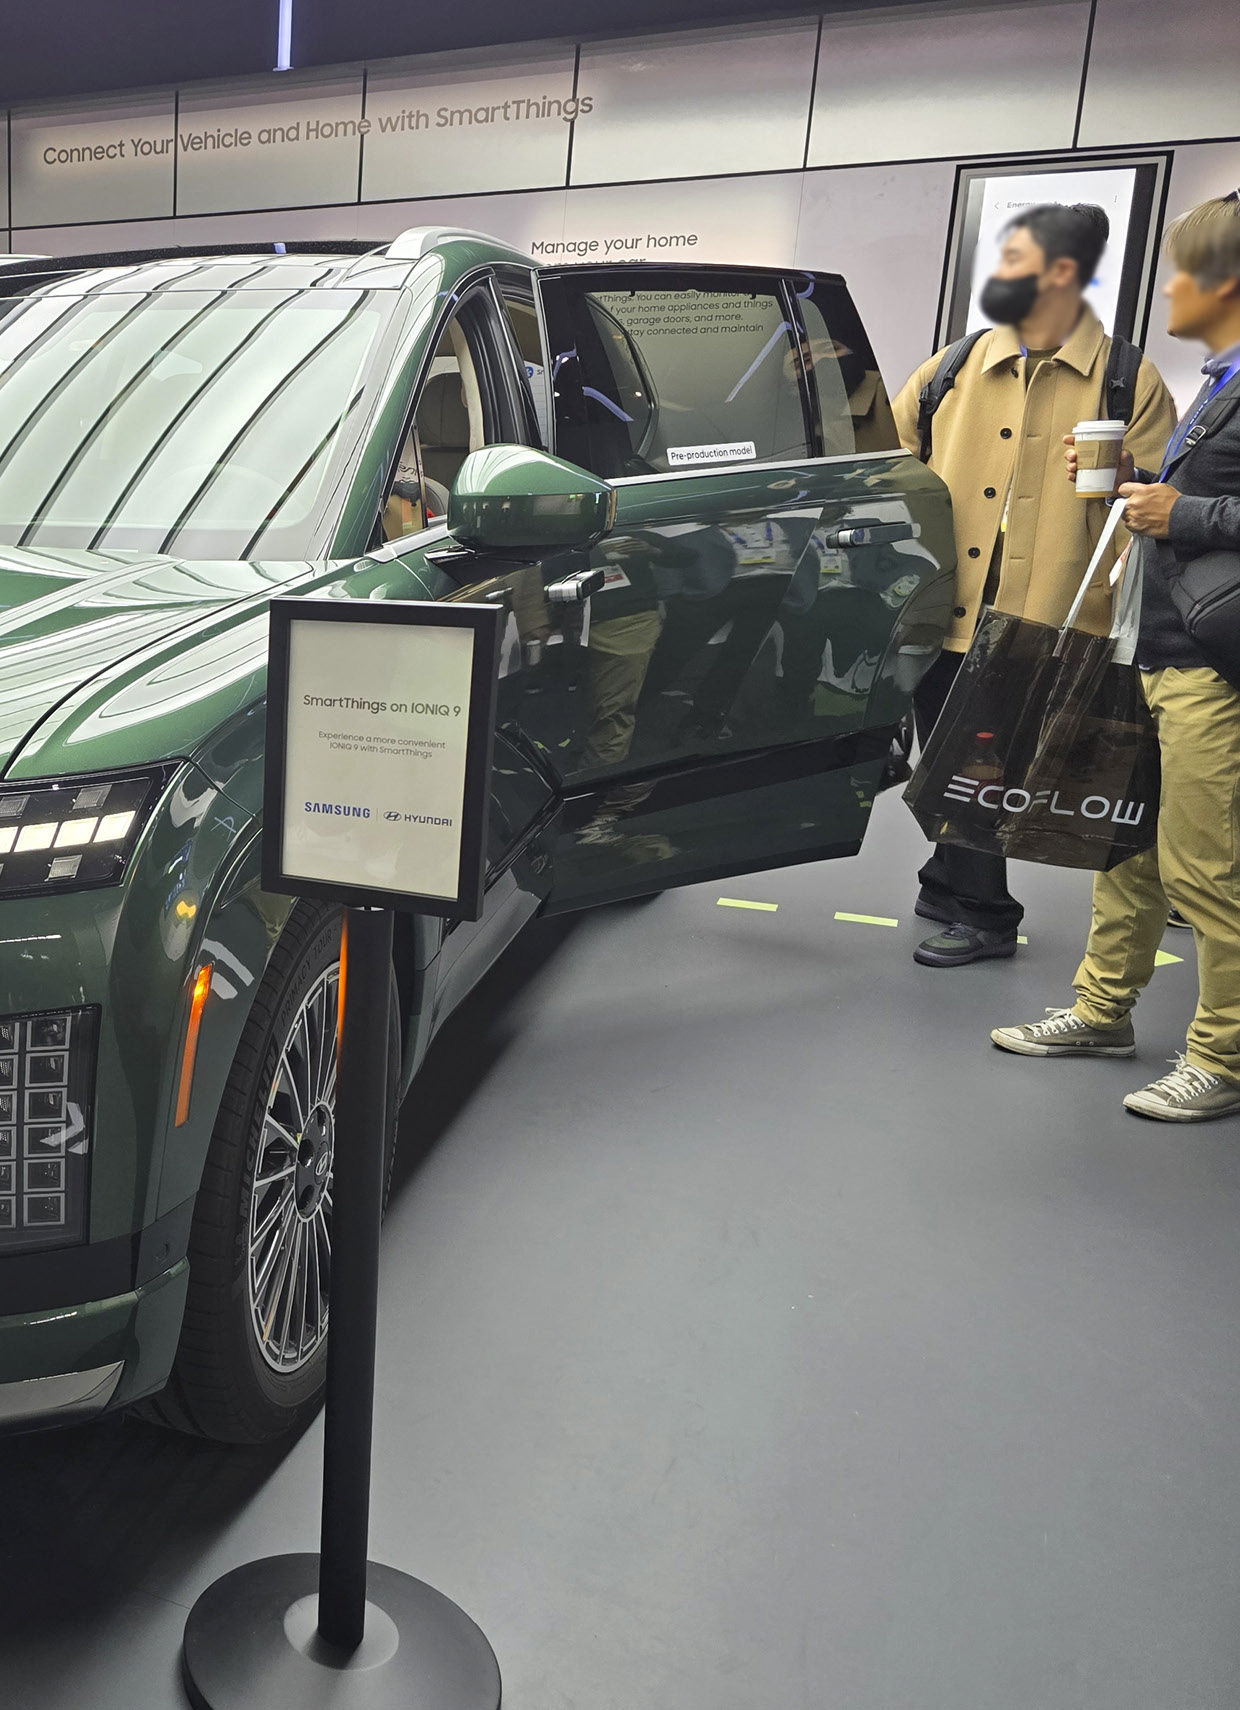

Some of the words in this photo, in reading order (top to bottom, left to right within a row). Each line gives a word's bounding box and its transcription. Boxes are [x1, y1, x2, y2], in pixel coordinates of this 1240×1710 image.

[42, 140, 126, 166] Connect
[130, 136, 174, 159] Your
[179, 127, 252, 153] Vehicle
[257, 121, 300, 146] and
[305, 117, 371, 141] Home
[378, 108, 430, 133] with
[434, 96, 594, 130] SmartThings
[531, 239, 599, 256] Manage
[604, 236, 642, 255] your
[646, 232, 698, 249] home
[596, 294, 634, 304] tThings.
[674, 291, 701, 300] easily
[615, 306, 636, 315] your
[638, 305, 666, 313] home
[667, 302, 720, 313] appliances
[722, 301, 742, 309] and
[743, 299, 773, 310] things
[626, 316, 661, 326] garage
[663, 315, 692, 323] doors,
[694, 314, 713, 322] and
[715, 313, 744, 321] more.
[647, 326, 698, 336] connected
[700, 326, 719, 334] and
[720, 324, 764, 333] maintain
[670, 448, 728, 461] Pre-production
[729, 446, 753, 456] model
[303, 694, 387, 714] SmartThings
[390, 702, 408, 714] on
[410, 702, 450, 717] IONIQ
[453, 705, 462, 718] 9
[318, 731, 365, 744] Experience
[373, 736, 396, 745] more
[398, 738, 446, 749] convenient
[329, 741, 352, 752] IONIQ
[353, 743, 359, 751] 9
[360, 743, 378, 753] with
[379, 745, 433, 759] SmartThings
[943, 774, 1145, 826] ECOFLOW
[304, 801, 371, 819] SAMSUNG
[404, 814, 453, 827] HYUNDAI
[238, 1048, 279, 1219] MICHELIN
